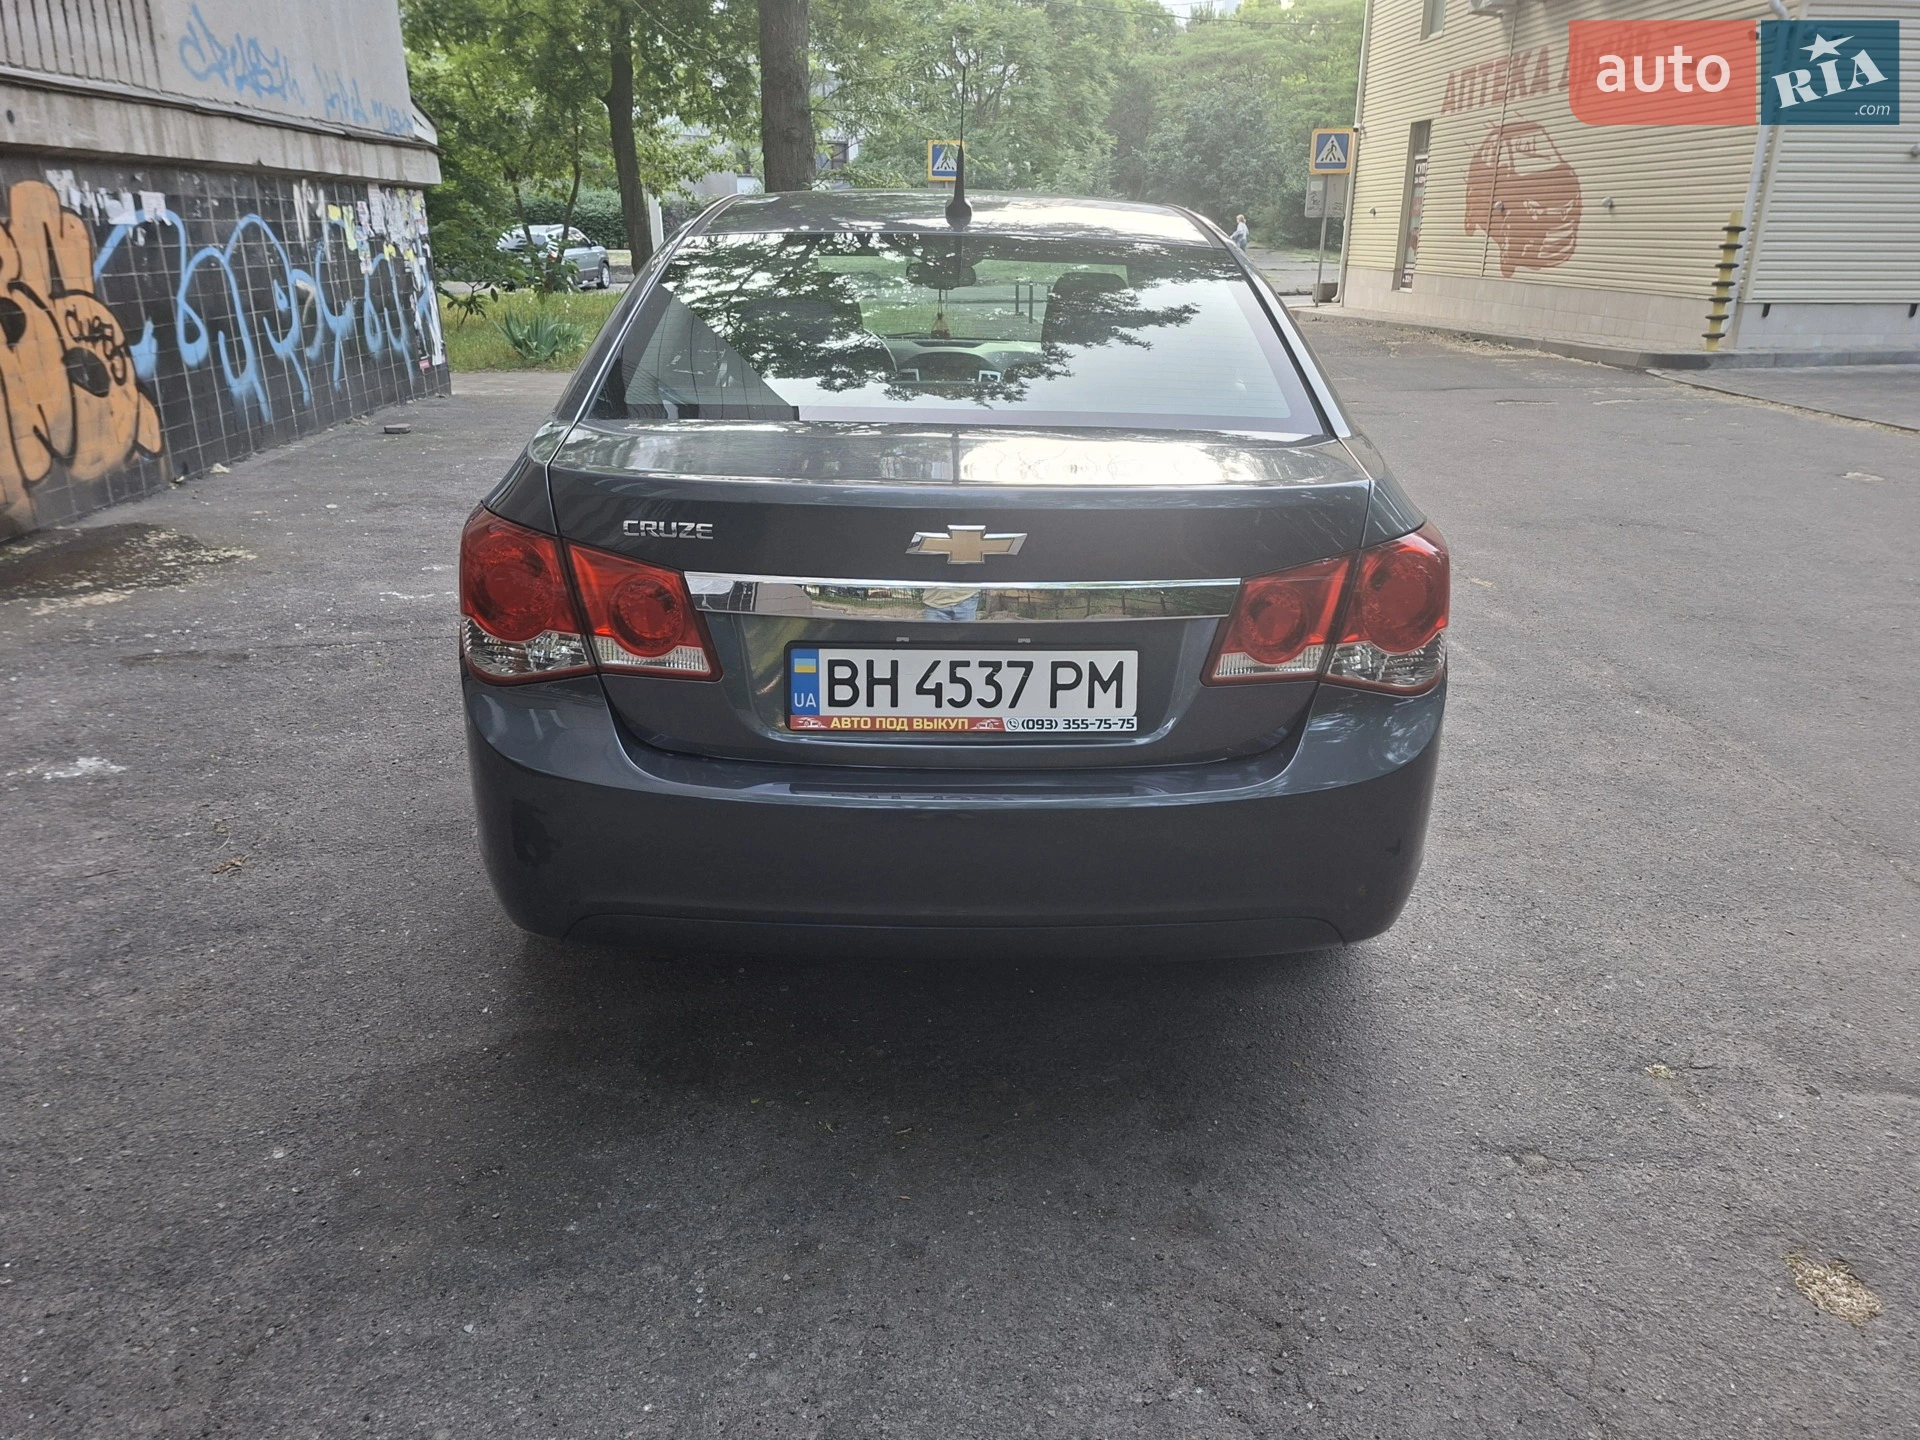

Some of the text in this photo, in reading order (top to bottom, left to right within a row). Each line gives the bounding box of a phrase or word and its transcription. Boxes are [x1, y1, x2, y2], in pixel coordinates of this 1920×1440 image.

[1441, 46, 1550, 115] АПТЕКА
[623, 520, 714, 539] CRUZE
[827, 659, 1124, 709] BH 4537 PM
[794, 693, 817, 708] UA
[830, 717, 969, 731] АВТО ПОД ВЫКУП
[1021, 719, 1135, 730] (093) 355-75-75
